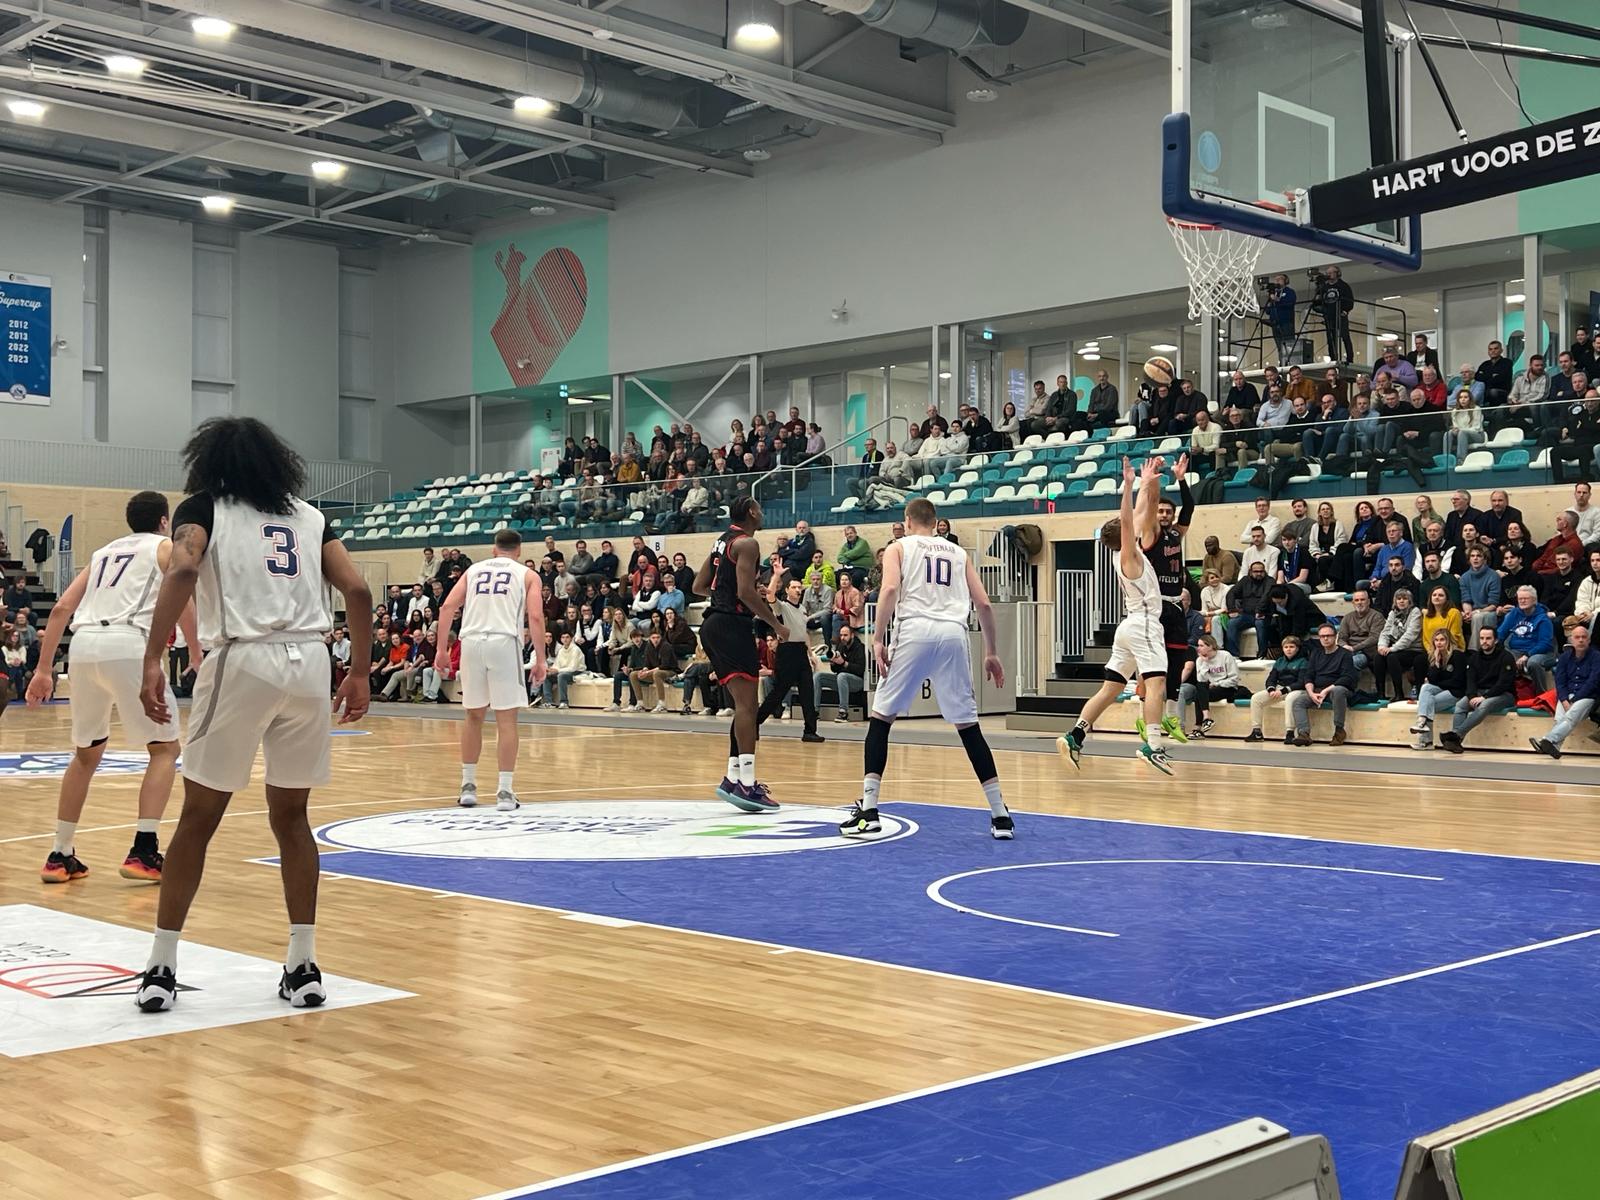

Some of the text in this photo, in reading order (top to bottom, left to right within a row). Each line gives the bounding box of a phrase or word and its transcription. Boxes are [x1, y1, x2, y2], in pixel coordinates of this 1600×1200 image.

[1372, 161, 1445, 199] HART
[1451, 141, 1530, 178] VOOR
[1536, 128, 1577, 158] DE
[8, 320, 29, 330] 2012
[8, 331, 29, 341] 2013
[8, 342, 29, 353] 2022
[8, 354, 29, 364] 2023
[262, 524, 301, 578] 3
[655, 541, 661, 551] B
[97, 553, 135, 588] 17
[924, 555, 952, 587] 10
[476, 571, 512, 595] 22
[922, 678, 931, 699] B
